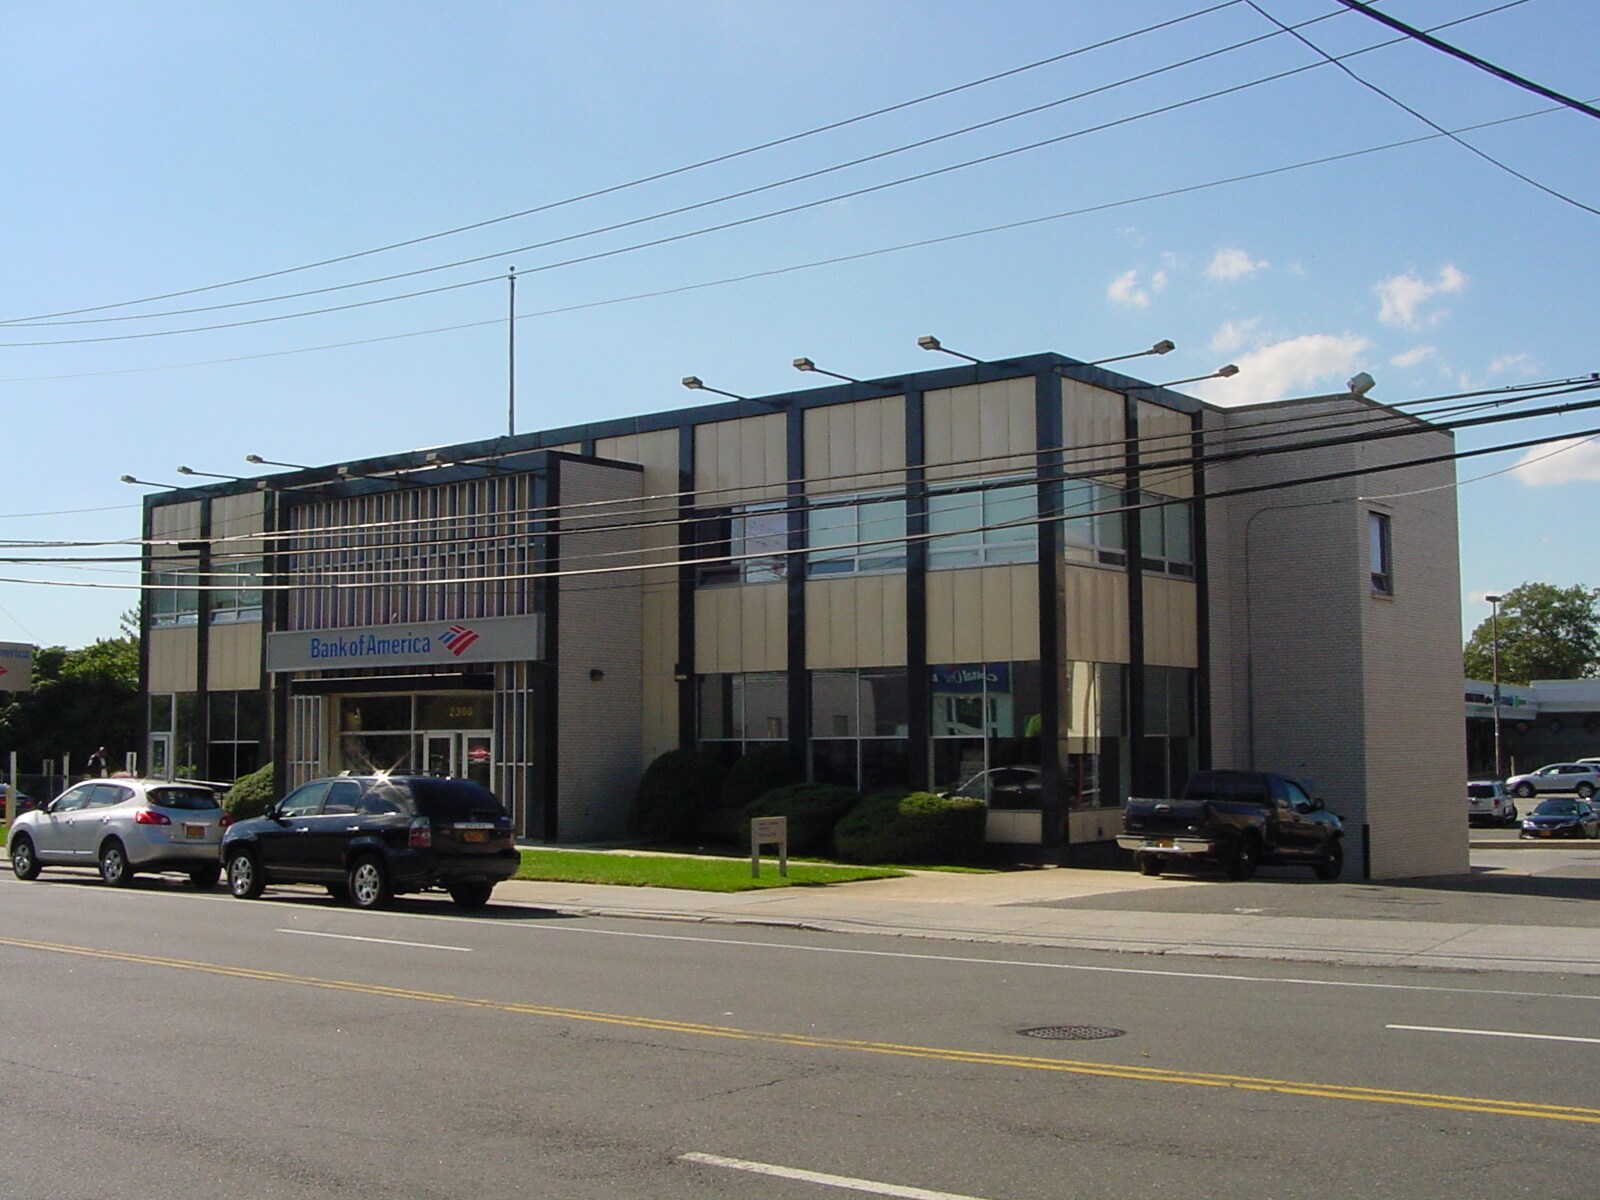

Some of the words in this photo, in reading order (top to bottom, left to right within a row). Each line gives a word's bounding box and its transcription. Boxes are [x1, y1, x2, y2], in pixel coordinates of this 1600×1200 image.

[311, 637, 347, 658] Bank
[350, 635, 365, 656] of
[367, 633, 430, 655] America
